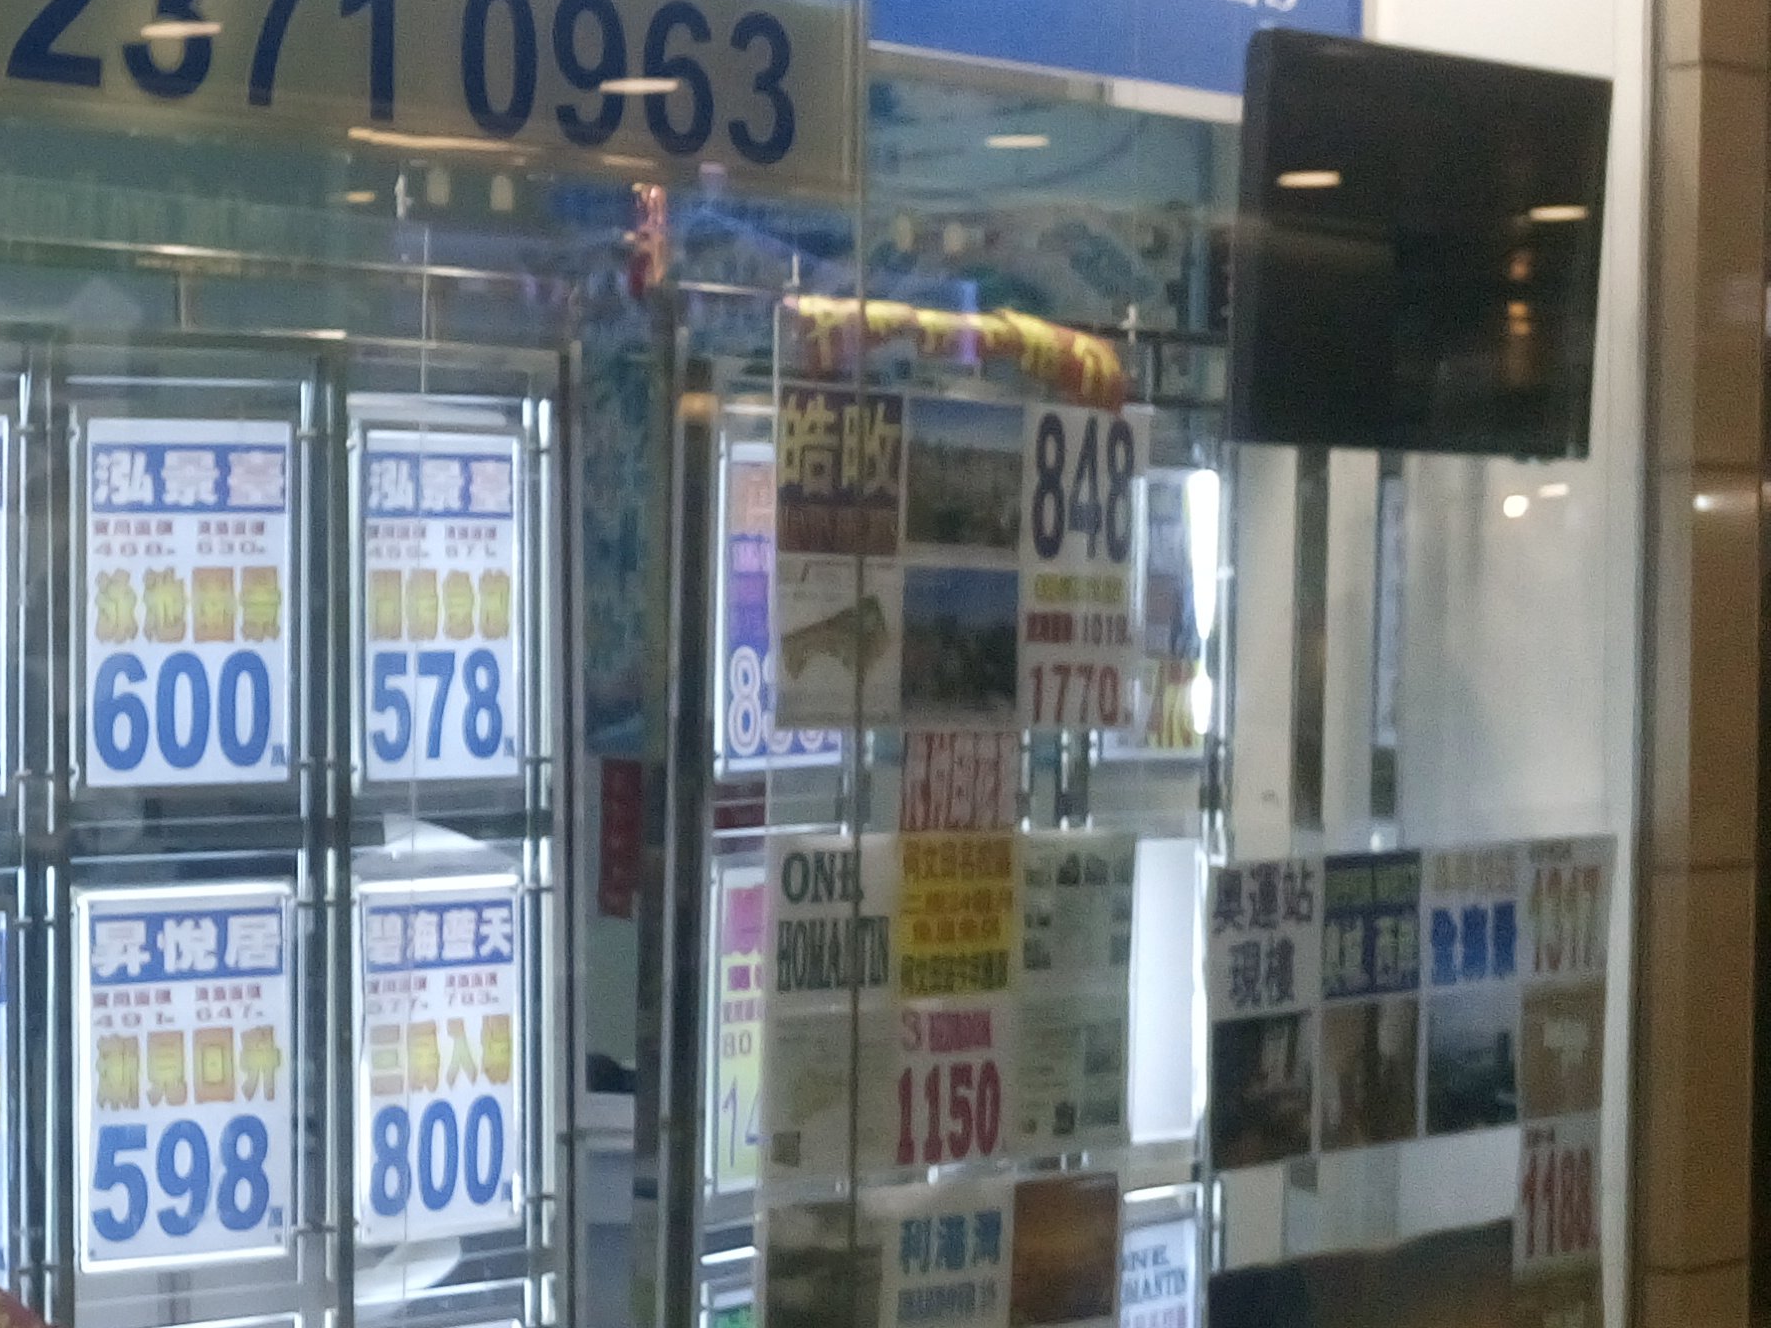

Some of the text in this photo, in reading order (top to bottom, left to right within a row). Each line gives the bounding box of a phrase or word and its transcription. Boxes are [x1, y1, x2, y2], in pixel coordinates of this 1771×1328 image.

[93, 450, 285, 506] 泓景臺
[1032, 412, 1135, 563] 848
[92, 916, 282, 975] 昇悅居
[897, 1059, 1002, 1165] 1150
